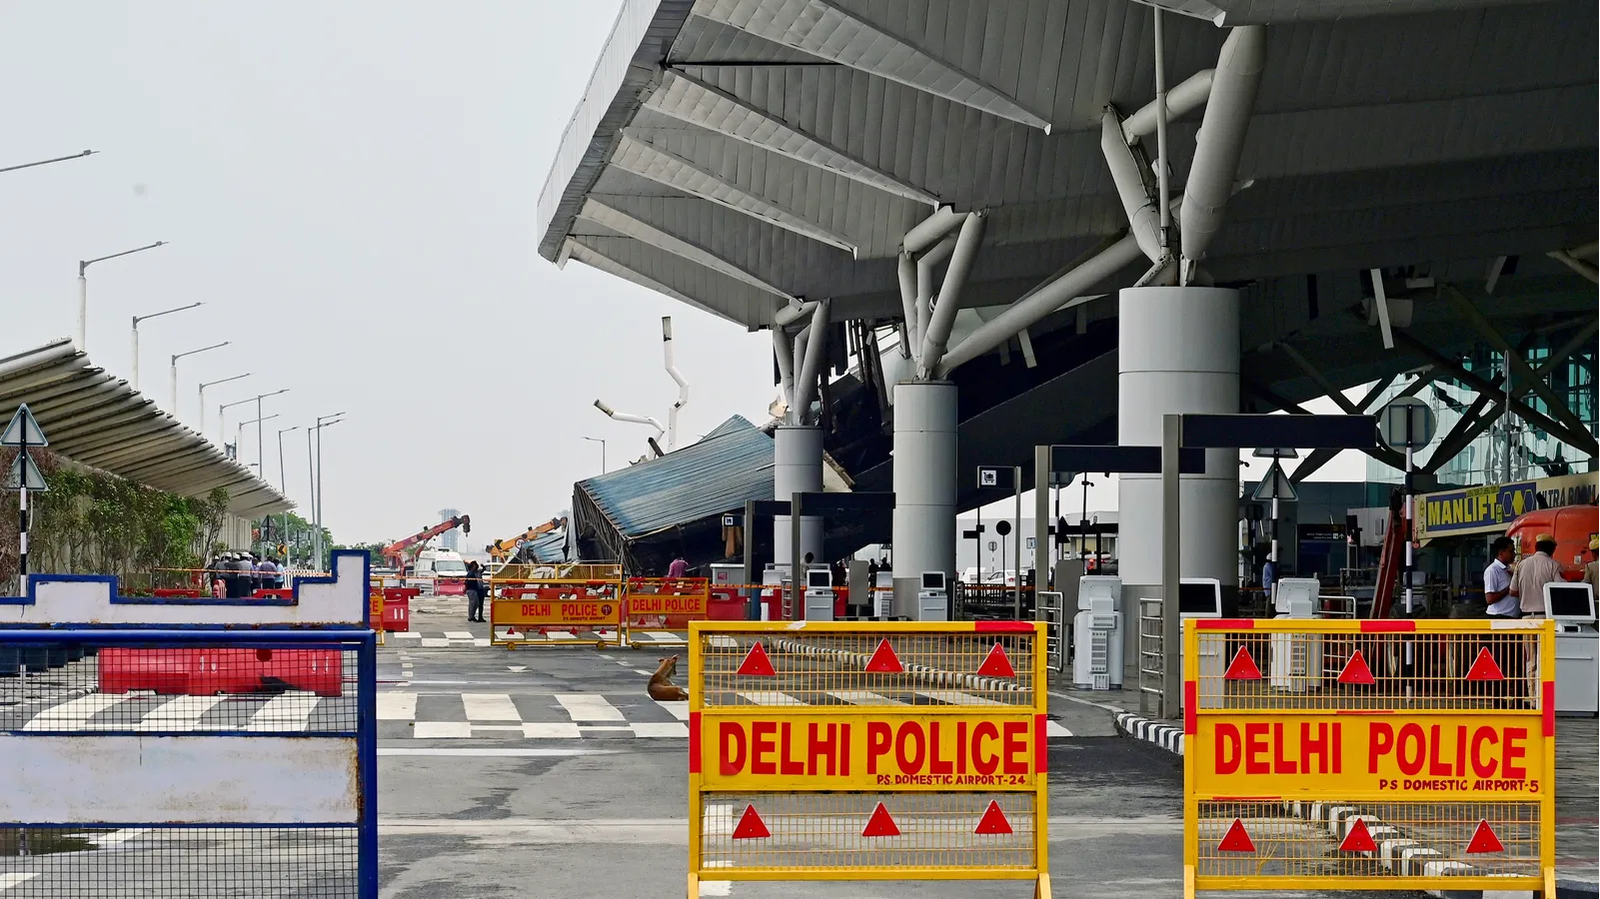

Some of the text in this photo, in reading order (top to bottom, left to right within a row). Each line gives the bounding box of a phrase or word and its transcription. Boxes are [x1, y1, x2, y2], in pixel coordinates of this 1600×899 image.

[1427, 493, 1498, 526] MANLIFT
[521, 603, 597, 617] DELHI POLICE
[631, 598, 701, 612] DELHI POLICE
[719, 720, 1029, 777] DELHI POLICE
[1214, 721, 1528, 780] DELHI POLICE
[895, 774, 953, 786] DOMESTIC
[956, 774, 1026, 786] AIRPORT-24
[1403, 779, 1468, 791] DOMESTIC
[1472, 779, 1539, 793] AIRPORT-5
